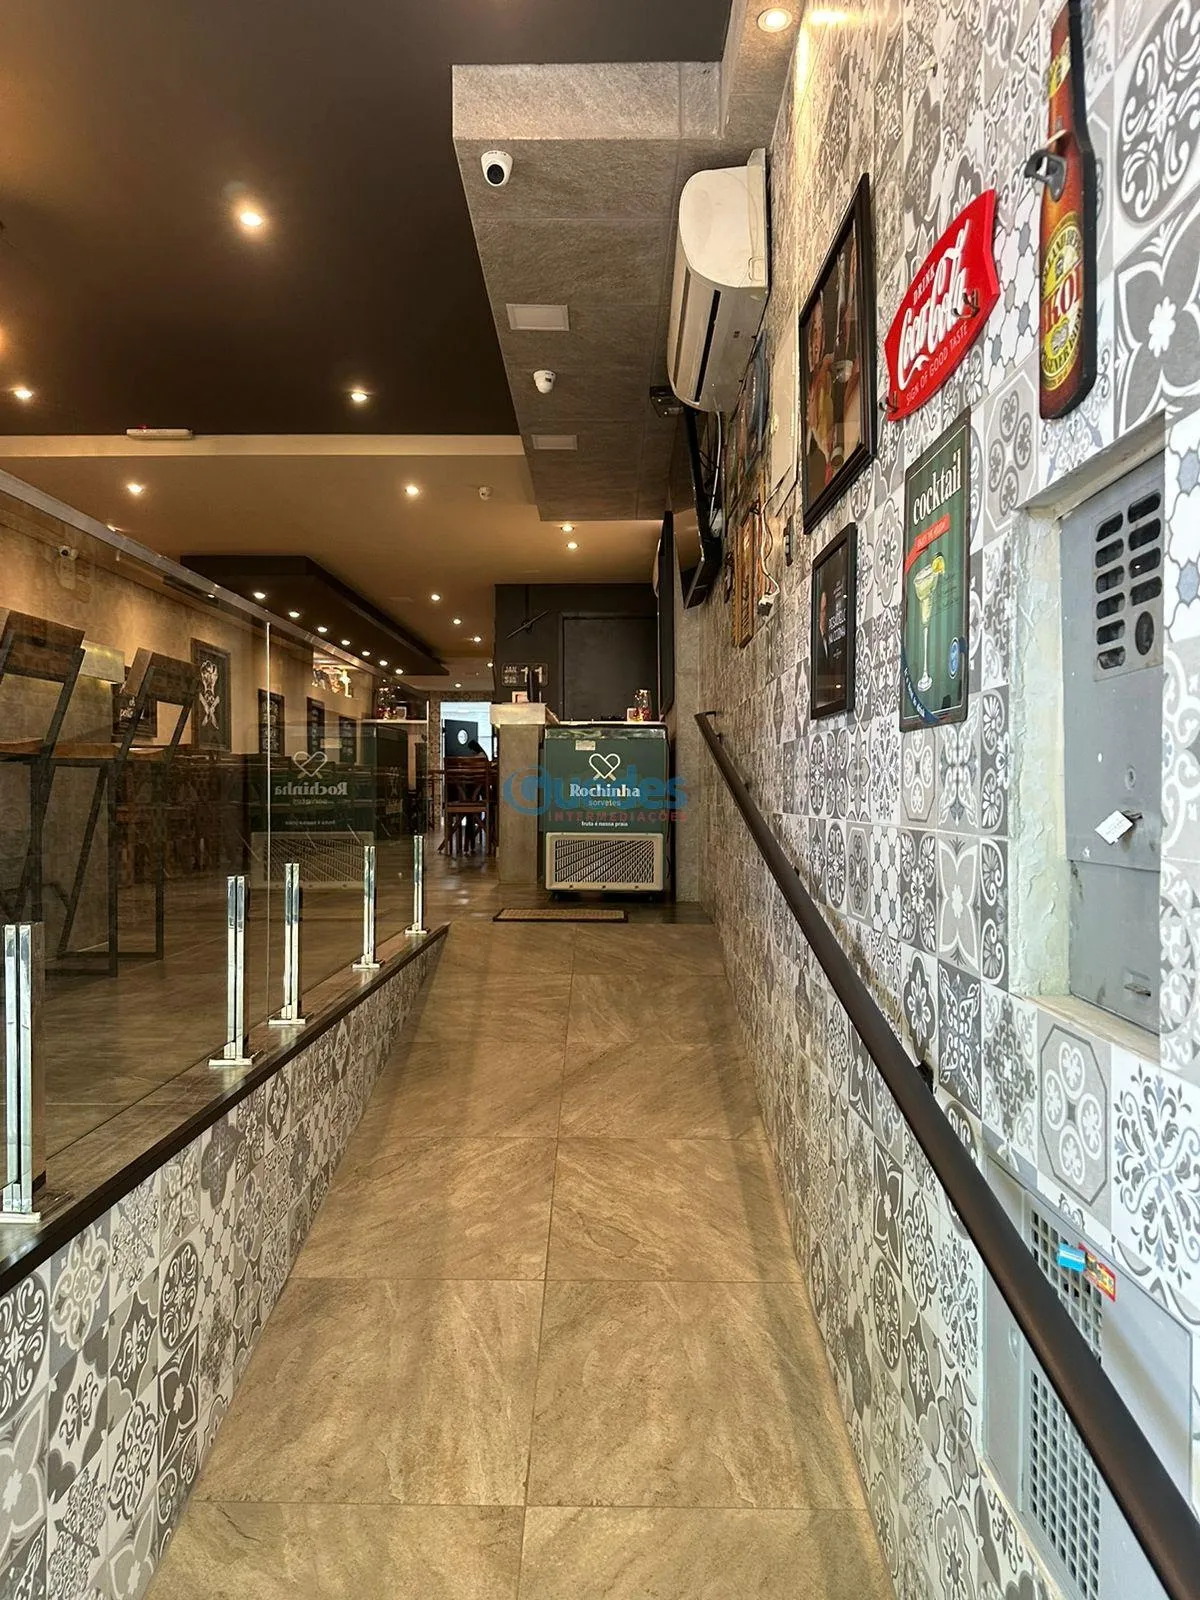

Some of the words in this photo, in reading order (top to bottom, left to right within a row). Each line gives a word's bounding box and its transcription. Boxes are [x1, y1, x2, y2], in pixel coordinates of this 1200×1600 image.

[912, 260, 937, 306] DRINK
[905, 382, 920, 406] SIGN
[920, 373, 928, 389] OF
[929, 348, 948, 377] GOOD
[950, 323, 968, 350] TASTE
[913, 447, 962, 526] cocktail
[569, 783, 641, 797] Rochinha
